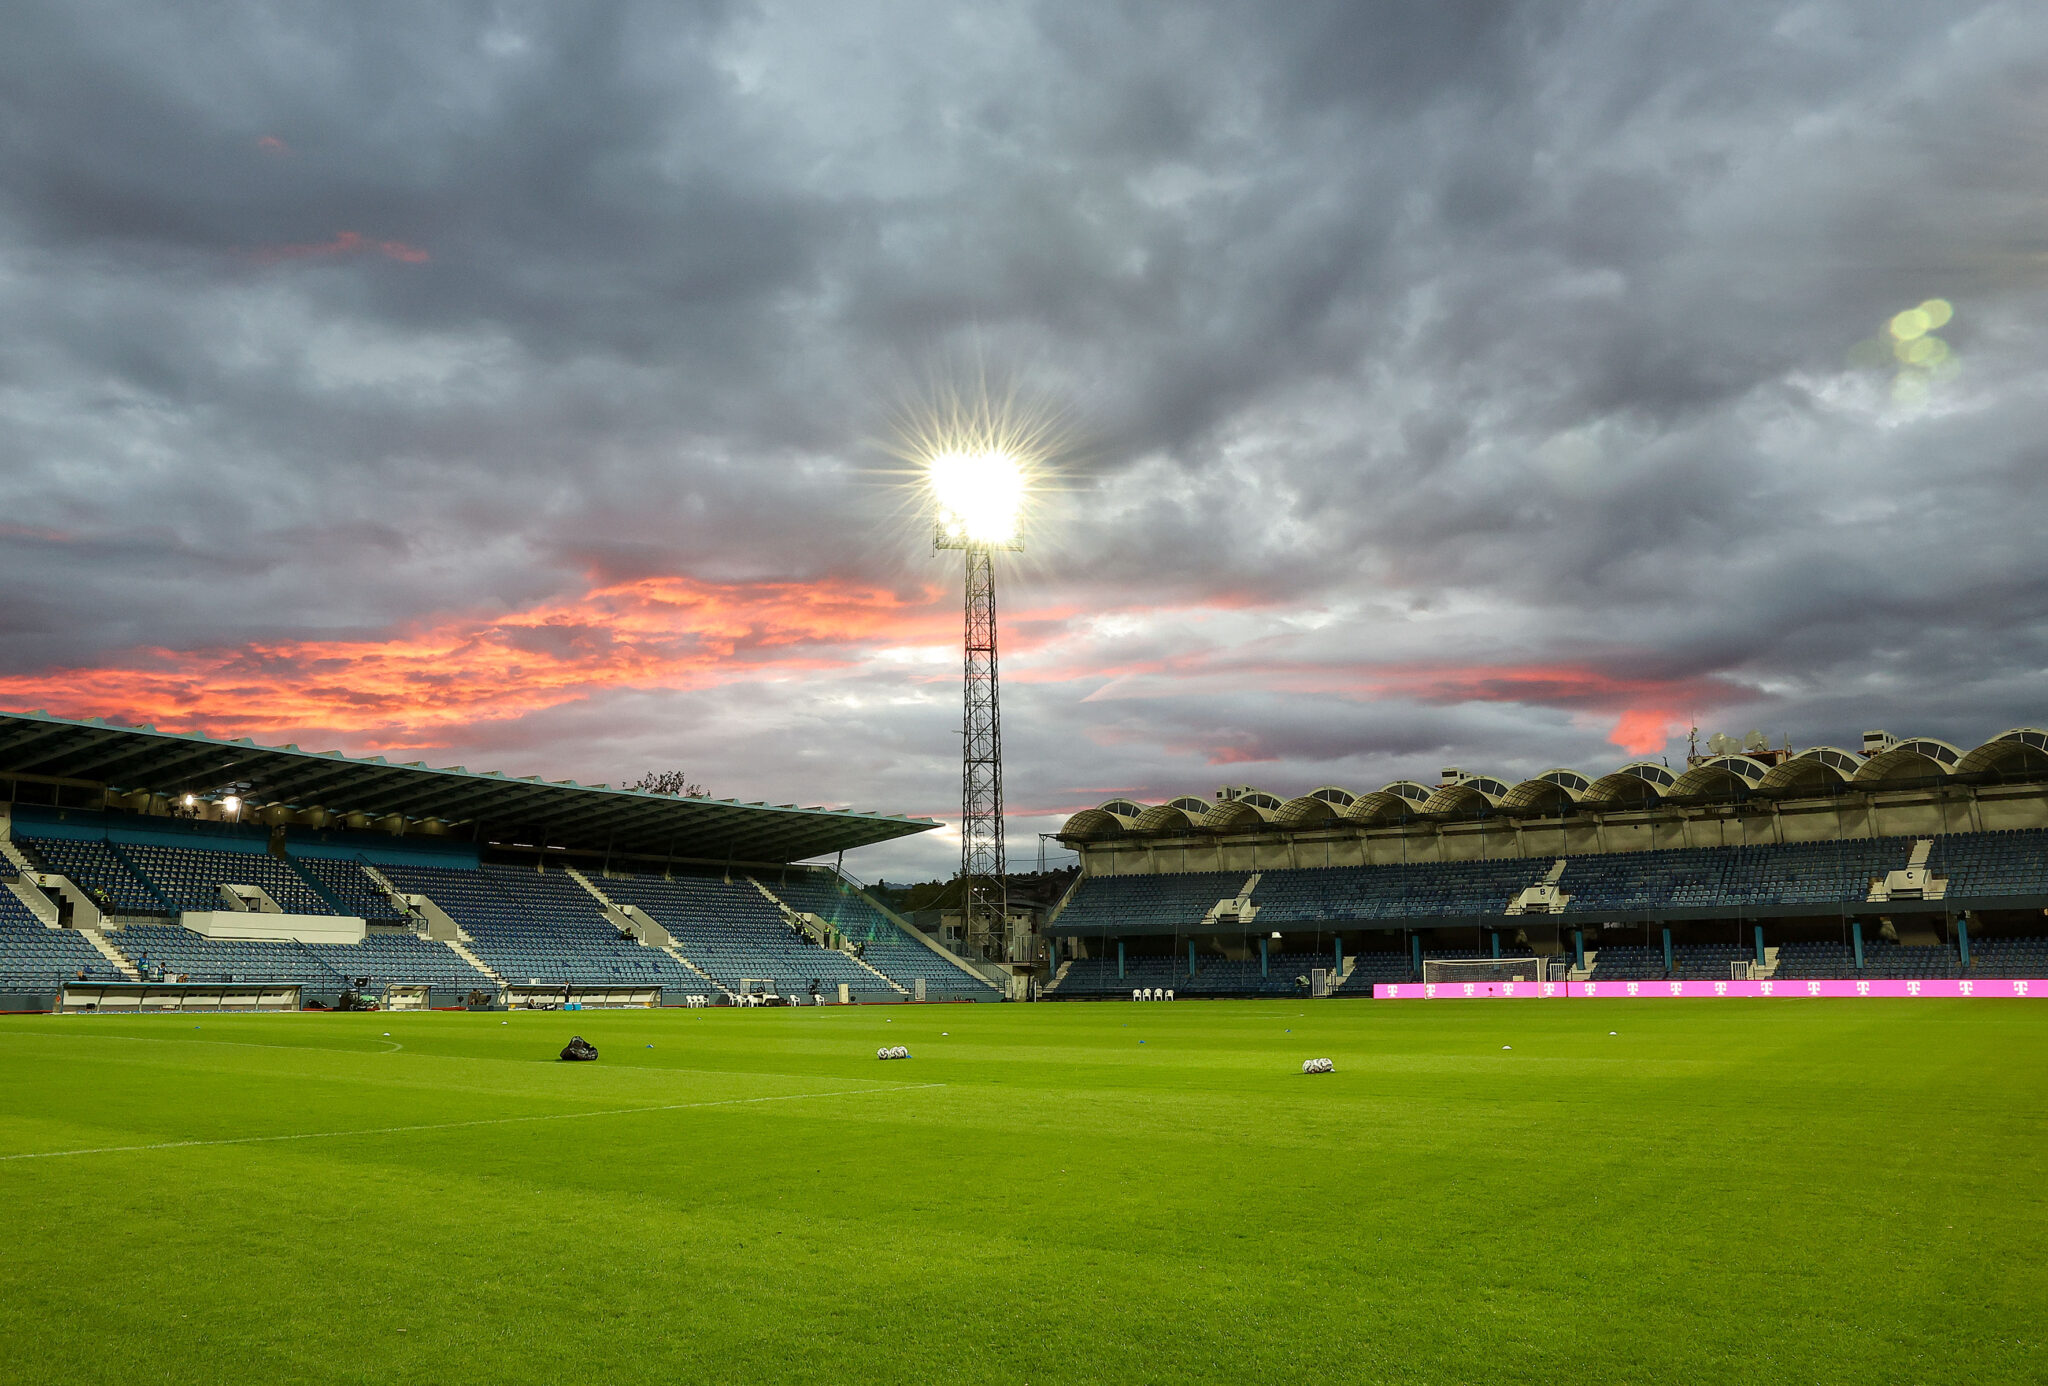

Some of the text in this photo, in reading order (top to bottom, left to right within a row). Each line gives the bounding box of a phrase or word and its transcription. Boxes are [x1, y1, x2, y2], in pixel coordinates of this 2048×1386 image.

[1388, 981, 2028, 997] T T T T T T T T T T T T T T T
